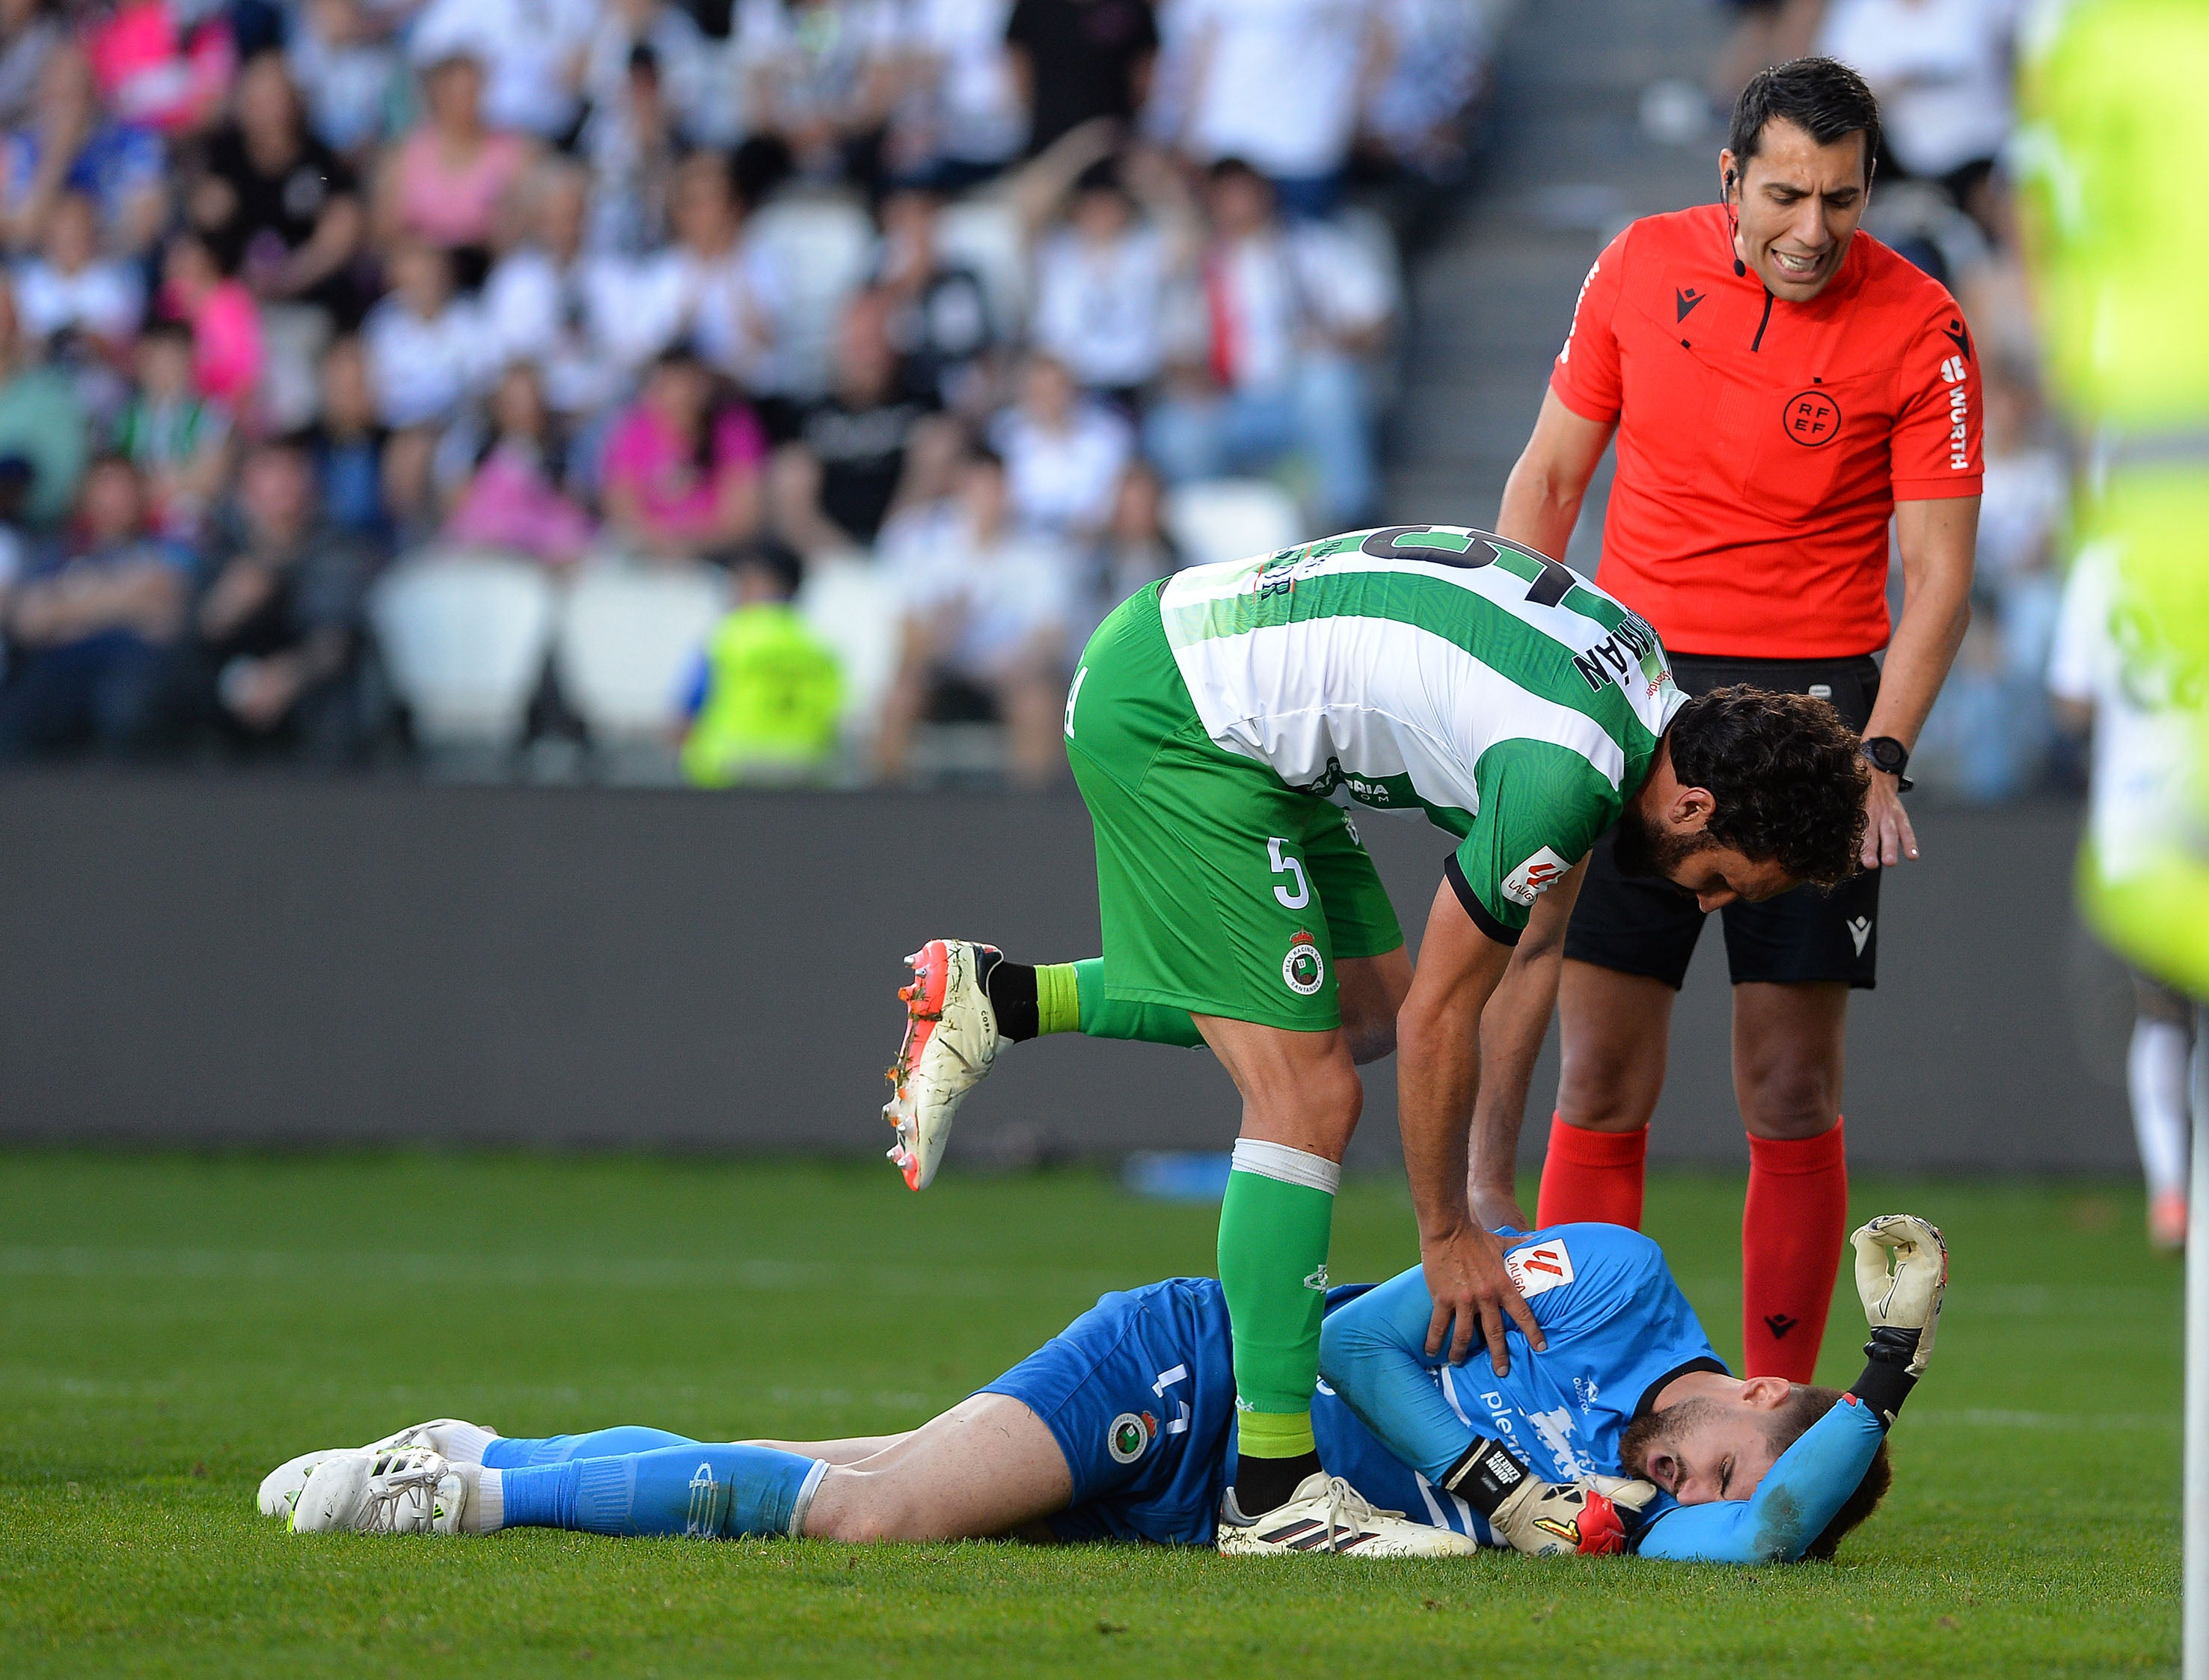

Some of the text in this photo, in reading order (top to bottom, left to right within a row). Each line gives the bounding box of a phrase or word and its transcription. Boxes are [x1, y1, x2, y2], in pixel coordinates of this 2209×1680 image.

[1949, 384, 1969, 470] WÜRTH
[1362, 525, 1577, 608] 5
[1266, 836, 1310, 910] 5
[1507, 1255, 1527, 1293] LALIGA
[1480, 1391, 1531, 1466] plenit
[1486, 1456, 1513, 1485] JOKIN
